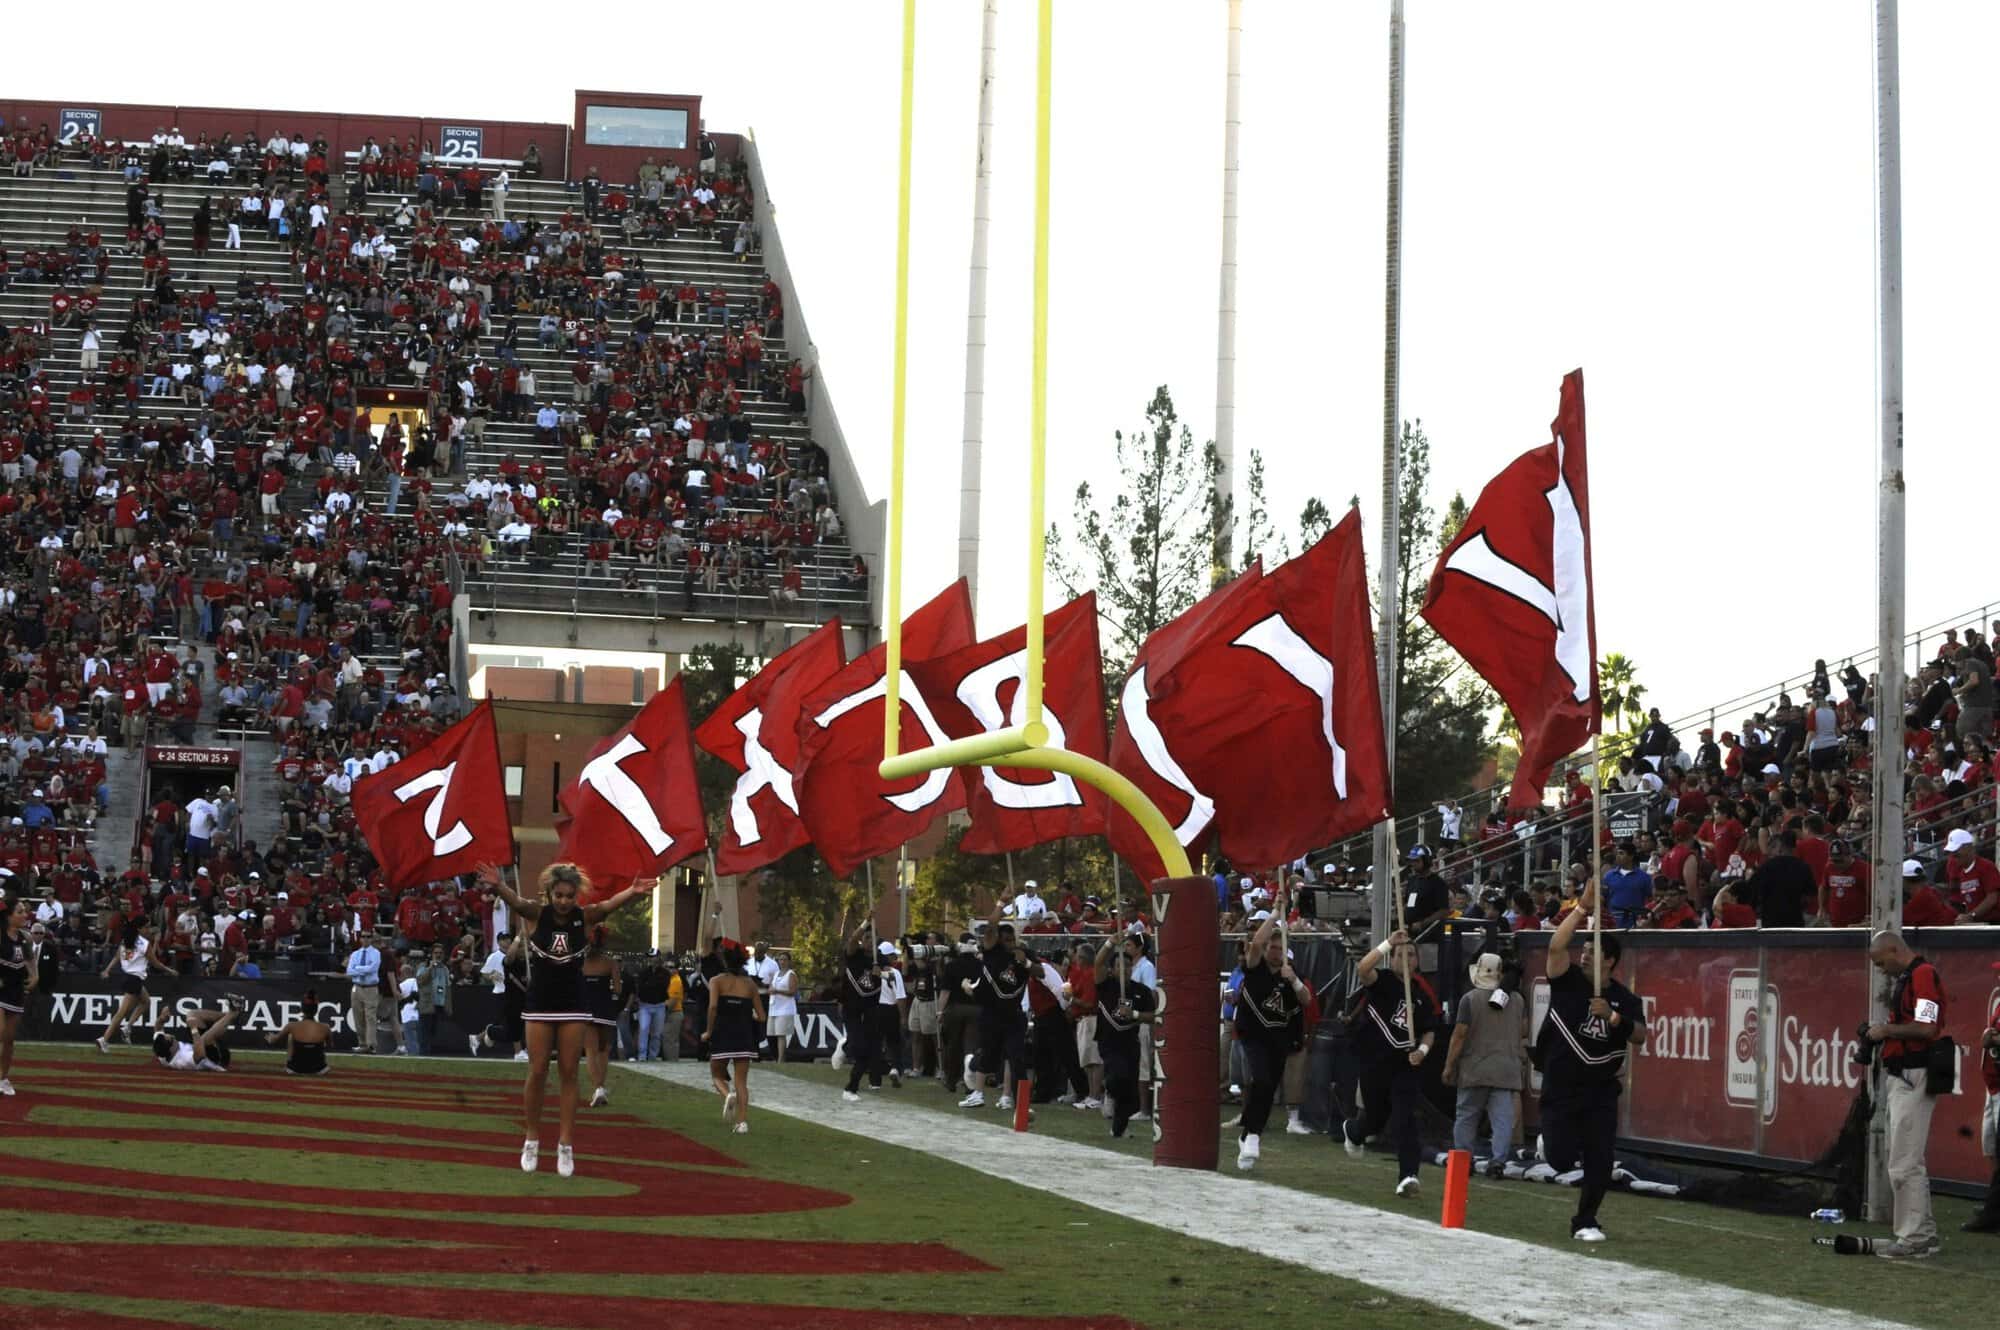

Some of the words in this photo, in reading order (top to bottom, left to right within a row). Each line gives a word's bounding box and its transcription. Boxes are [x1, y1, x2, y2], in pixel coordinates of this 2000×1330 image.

[65, 111, 97, 119] SECTION
[445, 139, 478, 161] 25
[1646, 729, 1655, 744] 7
[166, 751, 176, 761] 24
[177, 752, 209, 763] SECTION
[210, 753, 221, 763] 25
[551, 931, 569, 955] A
[51, 992, 203, 1028] WELLS
[1919, 1001, 1937, 1020] A
[1639, 996, 1711, 1061] Farm
[1782, 1015, 1860, 1089] State
